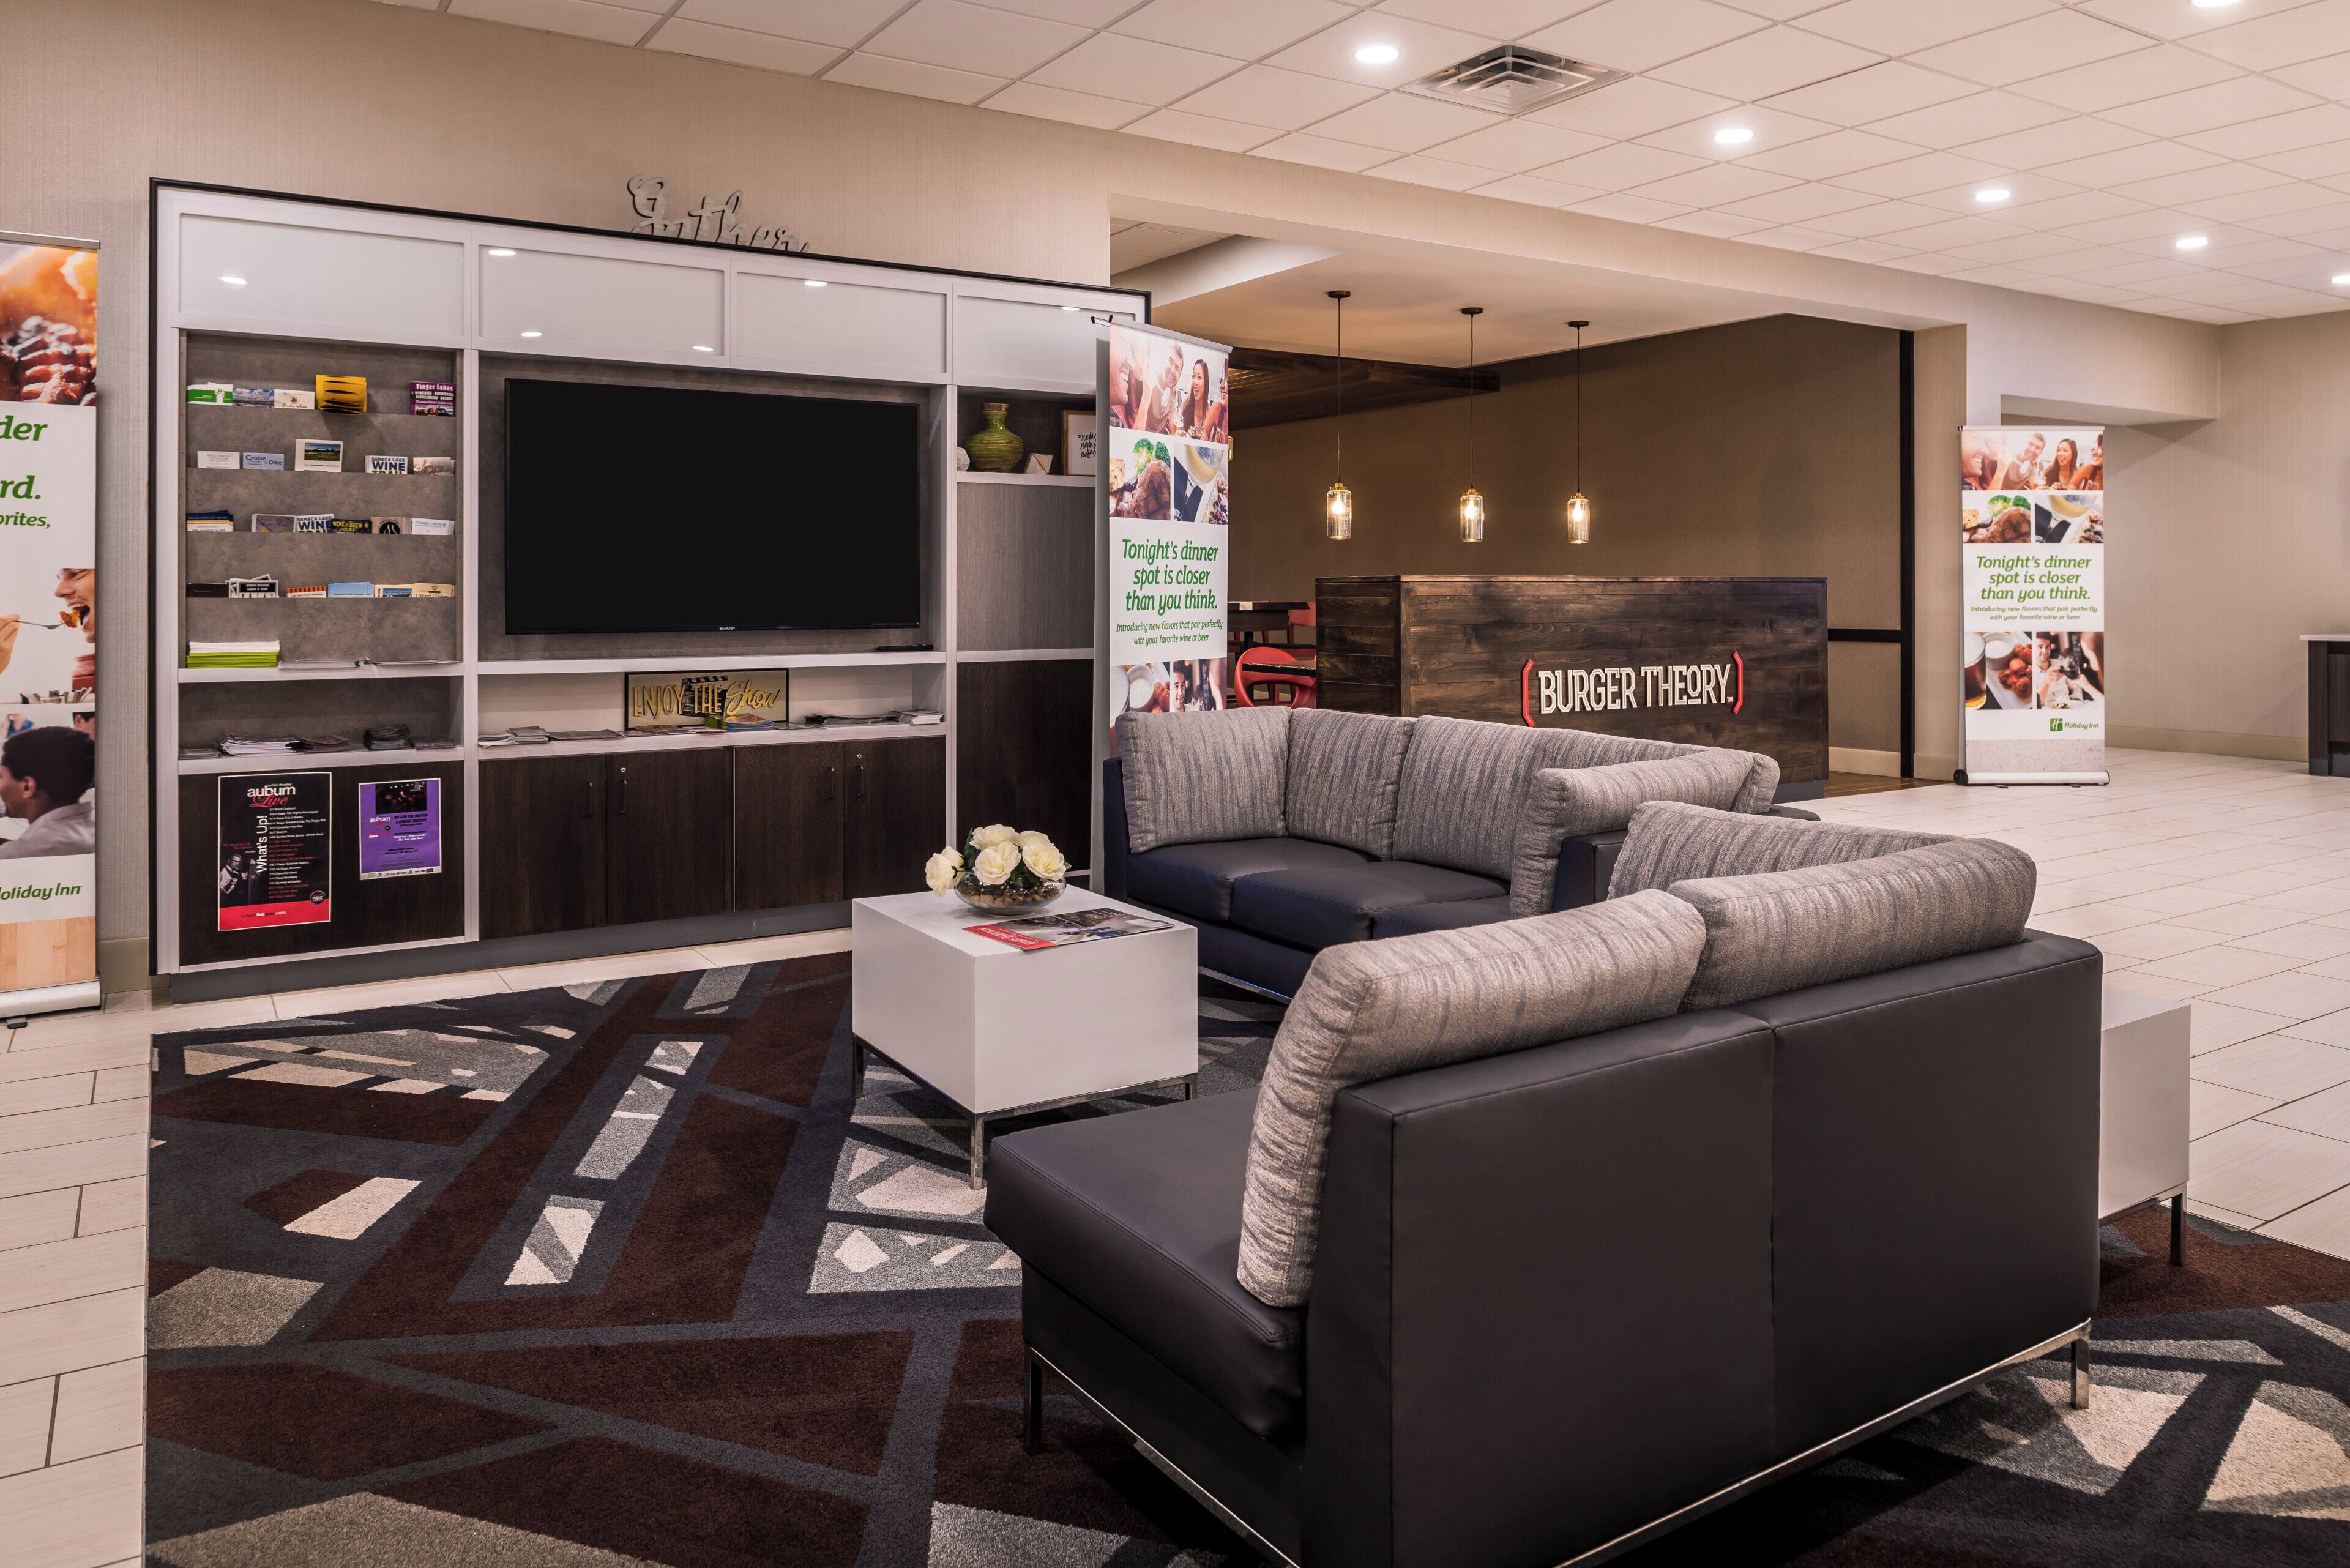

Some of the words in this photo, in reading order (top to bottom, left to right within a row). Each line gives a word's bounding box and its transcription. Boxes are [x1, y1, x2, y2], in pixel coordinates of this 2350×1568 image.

[371, 461, 405, 471] WINE
[297, 520, 332, 531] WINE
[1122, 539, 1178, 566] Tonight's
[1181, 540, 1219, 562] dinner
[1977, 555, 2041, 572] Tonight's
[2044, 555, 2092, 569] dinner
[1133, 566, 1161, 591] spot
[1163, 564, 1174, 585] is
[1176, 564, 1211, 585] closer
[1989, 571, 2020, 587] spot
[2024, 570, 2035, 584] is
[2039, 571, 2081, 584] closer
[1125, 589, 1155, 611] than
[1157, 594, 1182, 616] you
[1184, 589, 1218, 610] think.
[1980, 587, 2014, 600] than
[2017, 588, 2045, 603] you
[2049, 586, 2091, 600] think.
[1116, 622, 1148, 633] Introducing
[1161, 621, 1179, 630] flavors
[1179, 620, 1190, 629] that
[1190, 619, 1201, 630] pair
[1201, 619, 1223, 630] perfectly
[1133, 636, 1145, 645] with
[1146, 637, 1158, 646] your
[1159, 634, 1179, 643] favorite
[1179, 633, 1192, 642] wine
[1198, 633, 1210, 641] beer.
[1538, 667, 1638, 714] BURGER
[1641, 663, 1731, 707] THEORY
[633, 684, 685, 720] ENJOY
[692, 684, 722, 714] THE
[726, 679, 781, 715] Show
[247, 785, 296, 797] auburn
[249, 790, 289, 808] Live
[256, 816, 270, 834] Up!
[256, 836, 268, 873] What's
[0, 885, 53, 900] oliday
[54, 883, 81, 896] Inn
